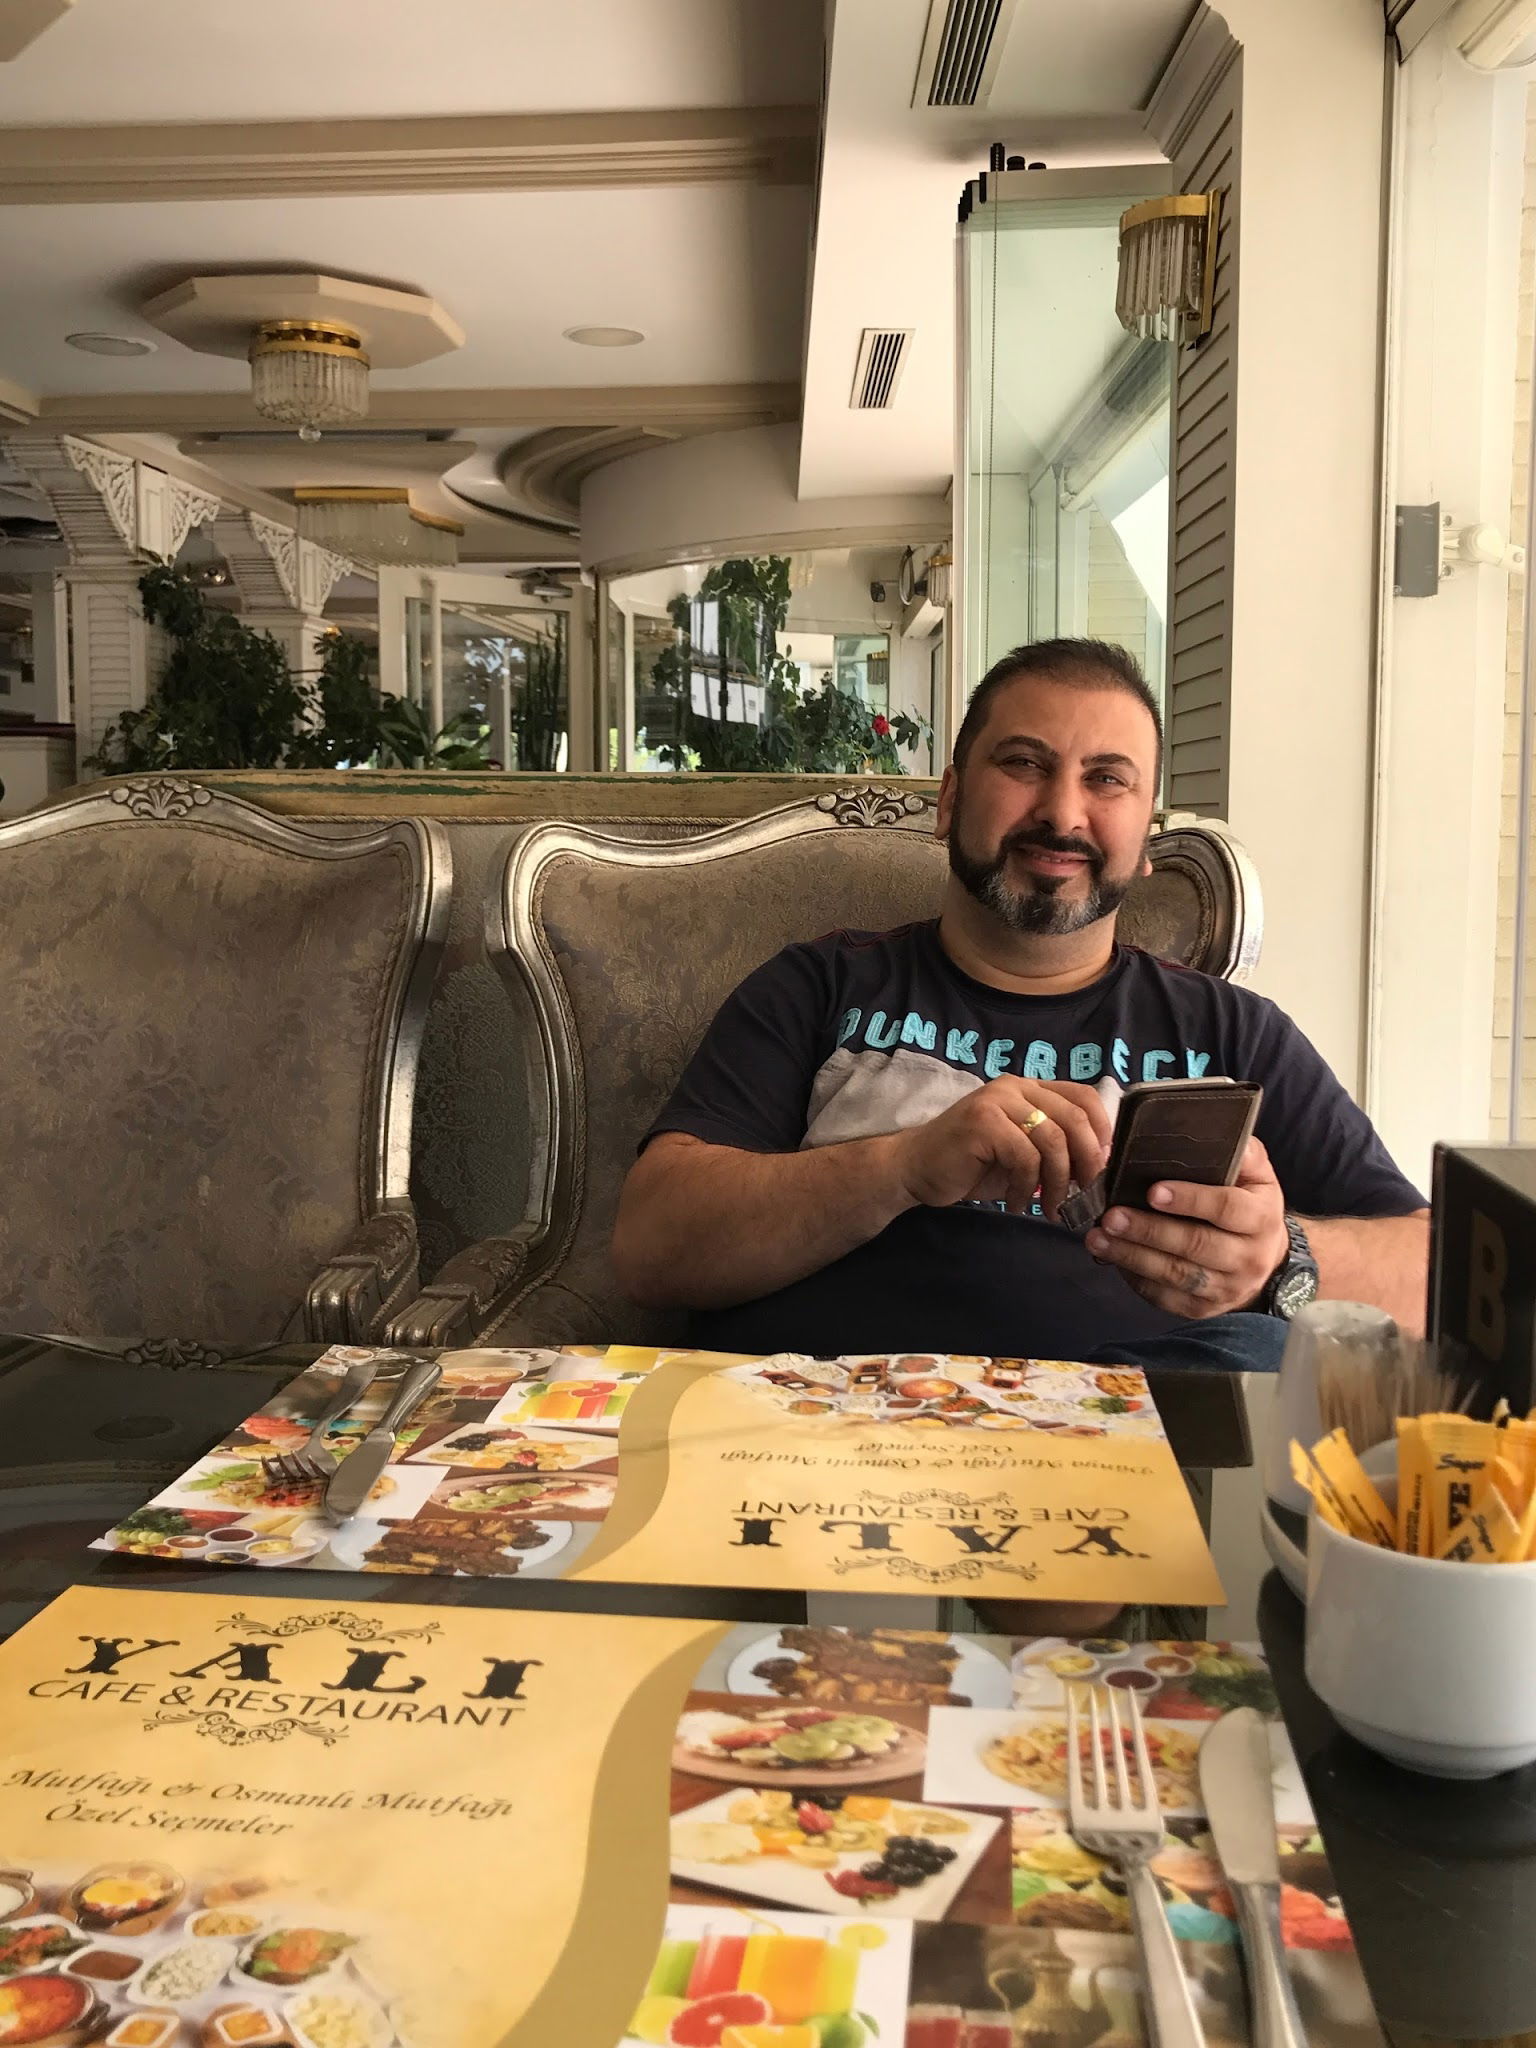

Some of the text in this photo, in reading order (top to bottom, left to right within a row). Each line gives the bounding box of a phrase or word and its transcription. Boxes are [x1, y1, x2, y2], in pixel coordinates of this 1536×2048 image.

[731, 1500, 1130, 1521] CAFE & RESTAURANT
[728, 1517, 1152, 1559] YALI
[64, 1635, 544, 1700] YALI
[28, 1680, 526, 1726] CAFE & RESTAURANT
[2, 1769, 513, 1820] Mutfağı & Osmanlı Mutfağı
[45, 1799, 294, 1836] Özel Seçmeler
